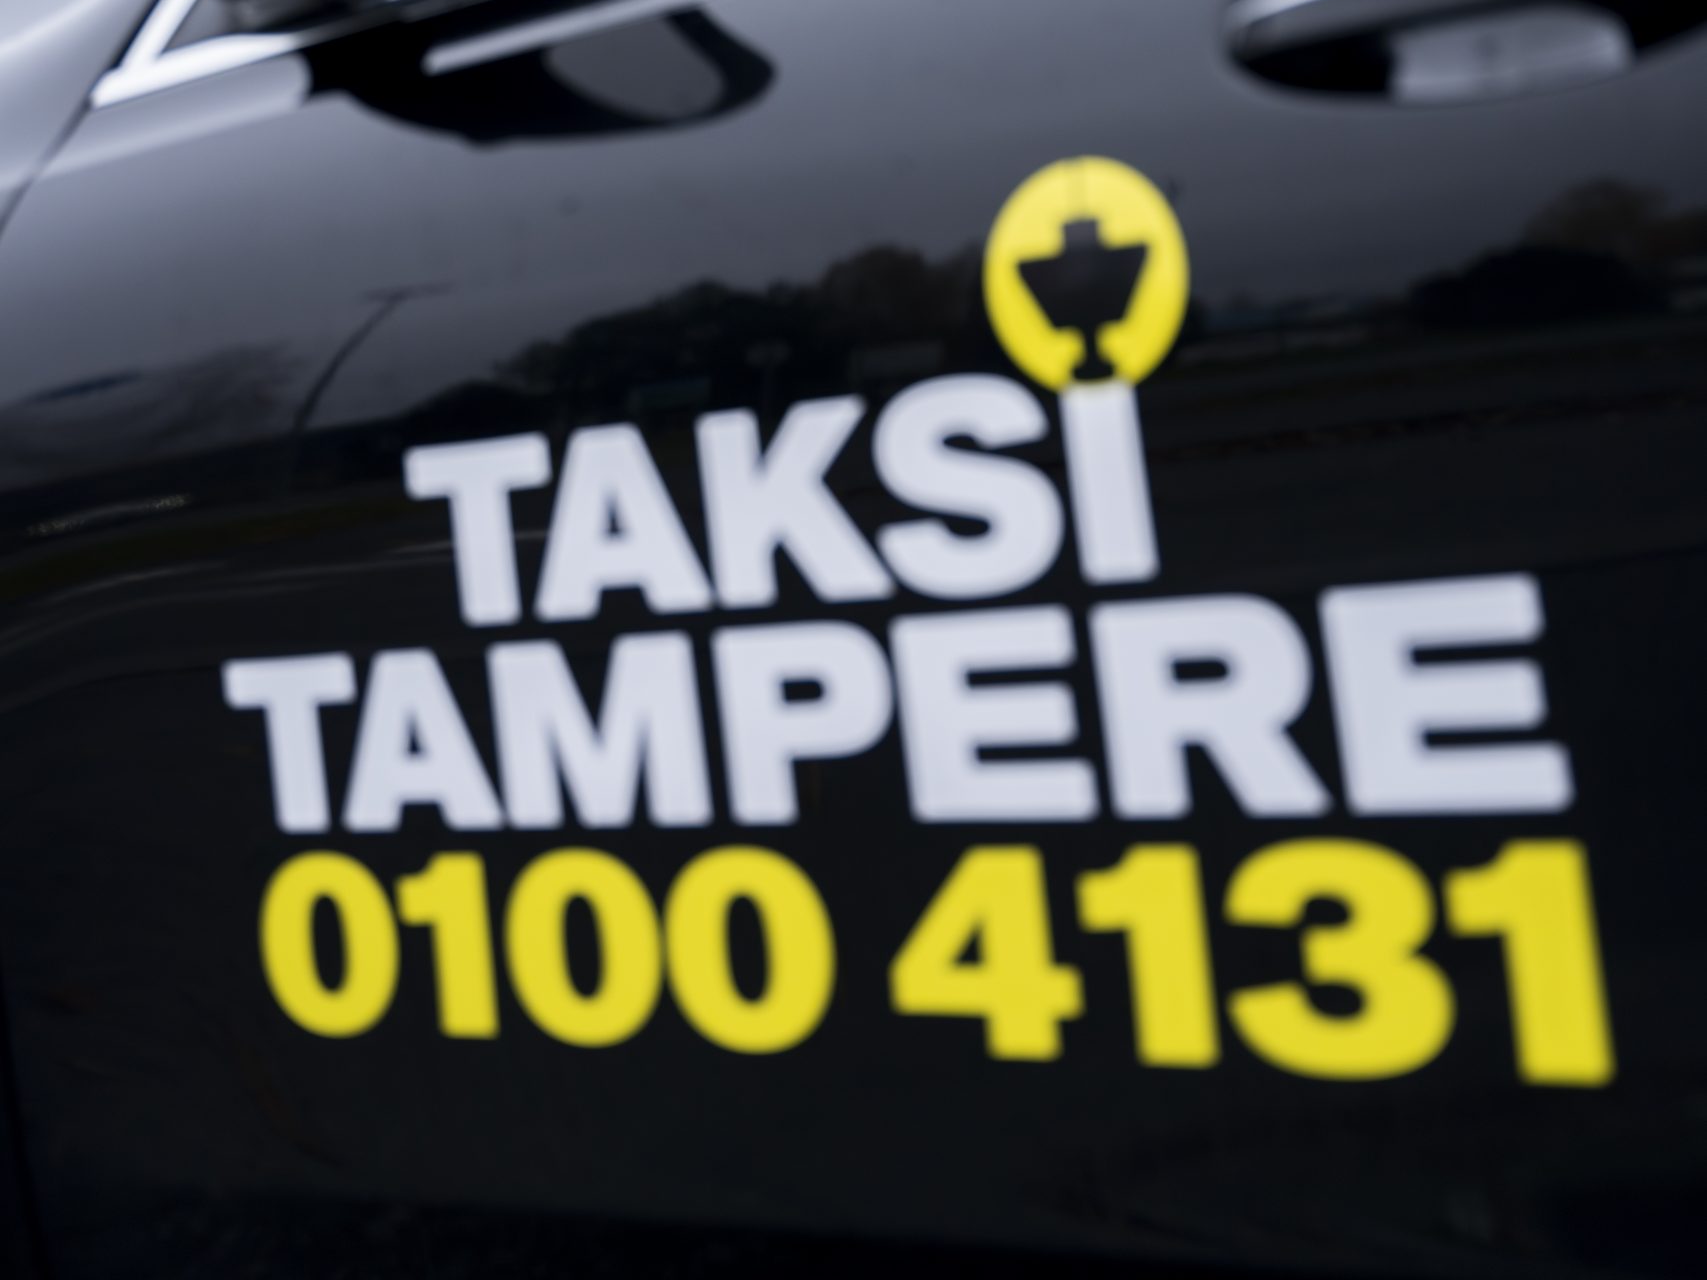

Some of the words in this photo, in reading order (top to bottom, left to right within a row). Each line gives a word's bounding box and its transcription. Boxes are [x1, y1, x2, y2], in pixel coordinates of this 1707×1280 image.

[404, 371, 1161, 627] TAKSI
[223, 572, 1576, 834] TAMPERE
[260, 843, 838, 1056] 0100
[890, 836, 1615, 1086] 4131
